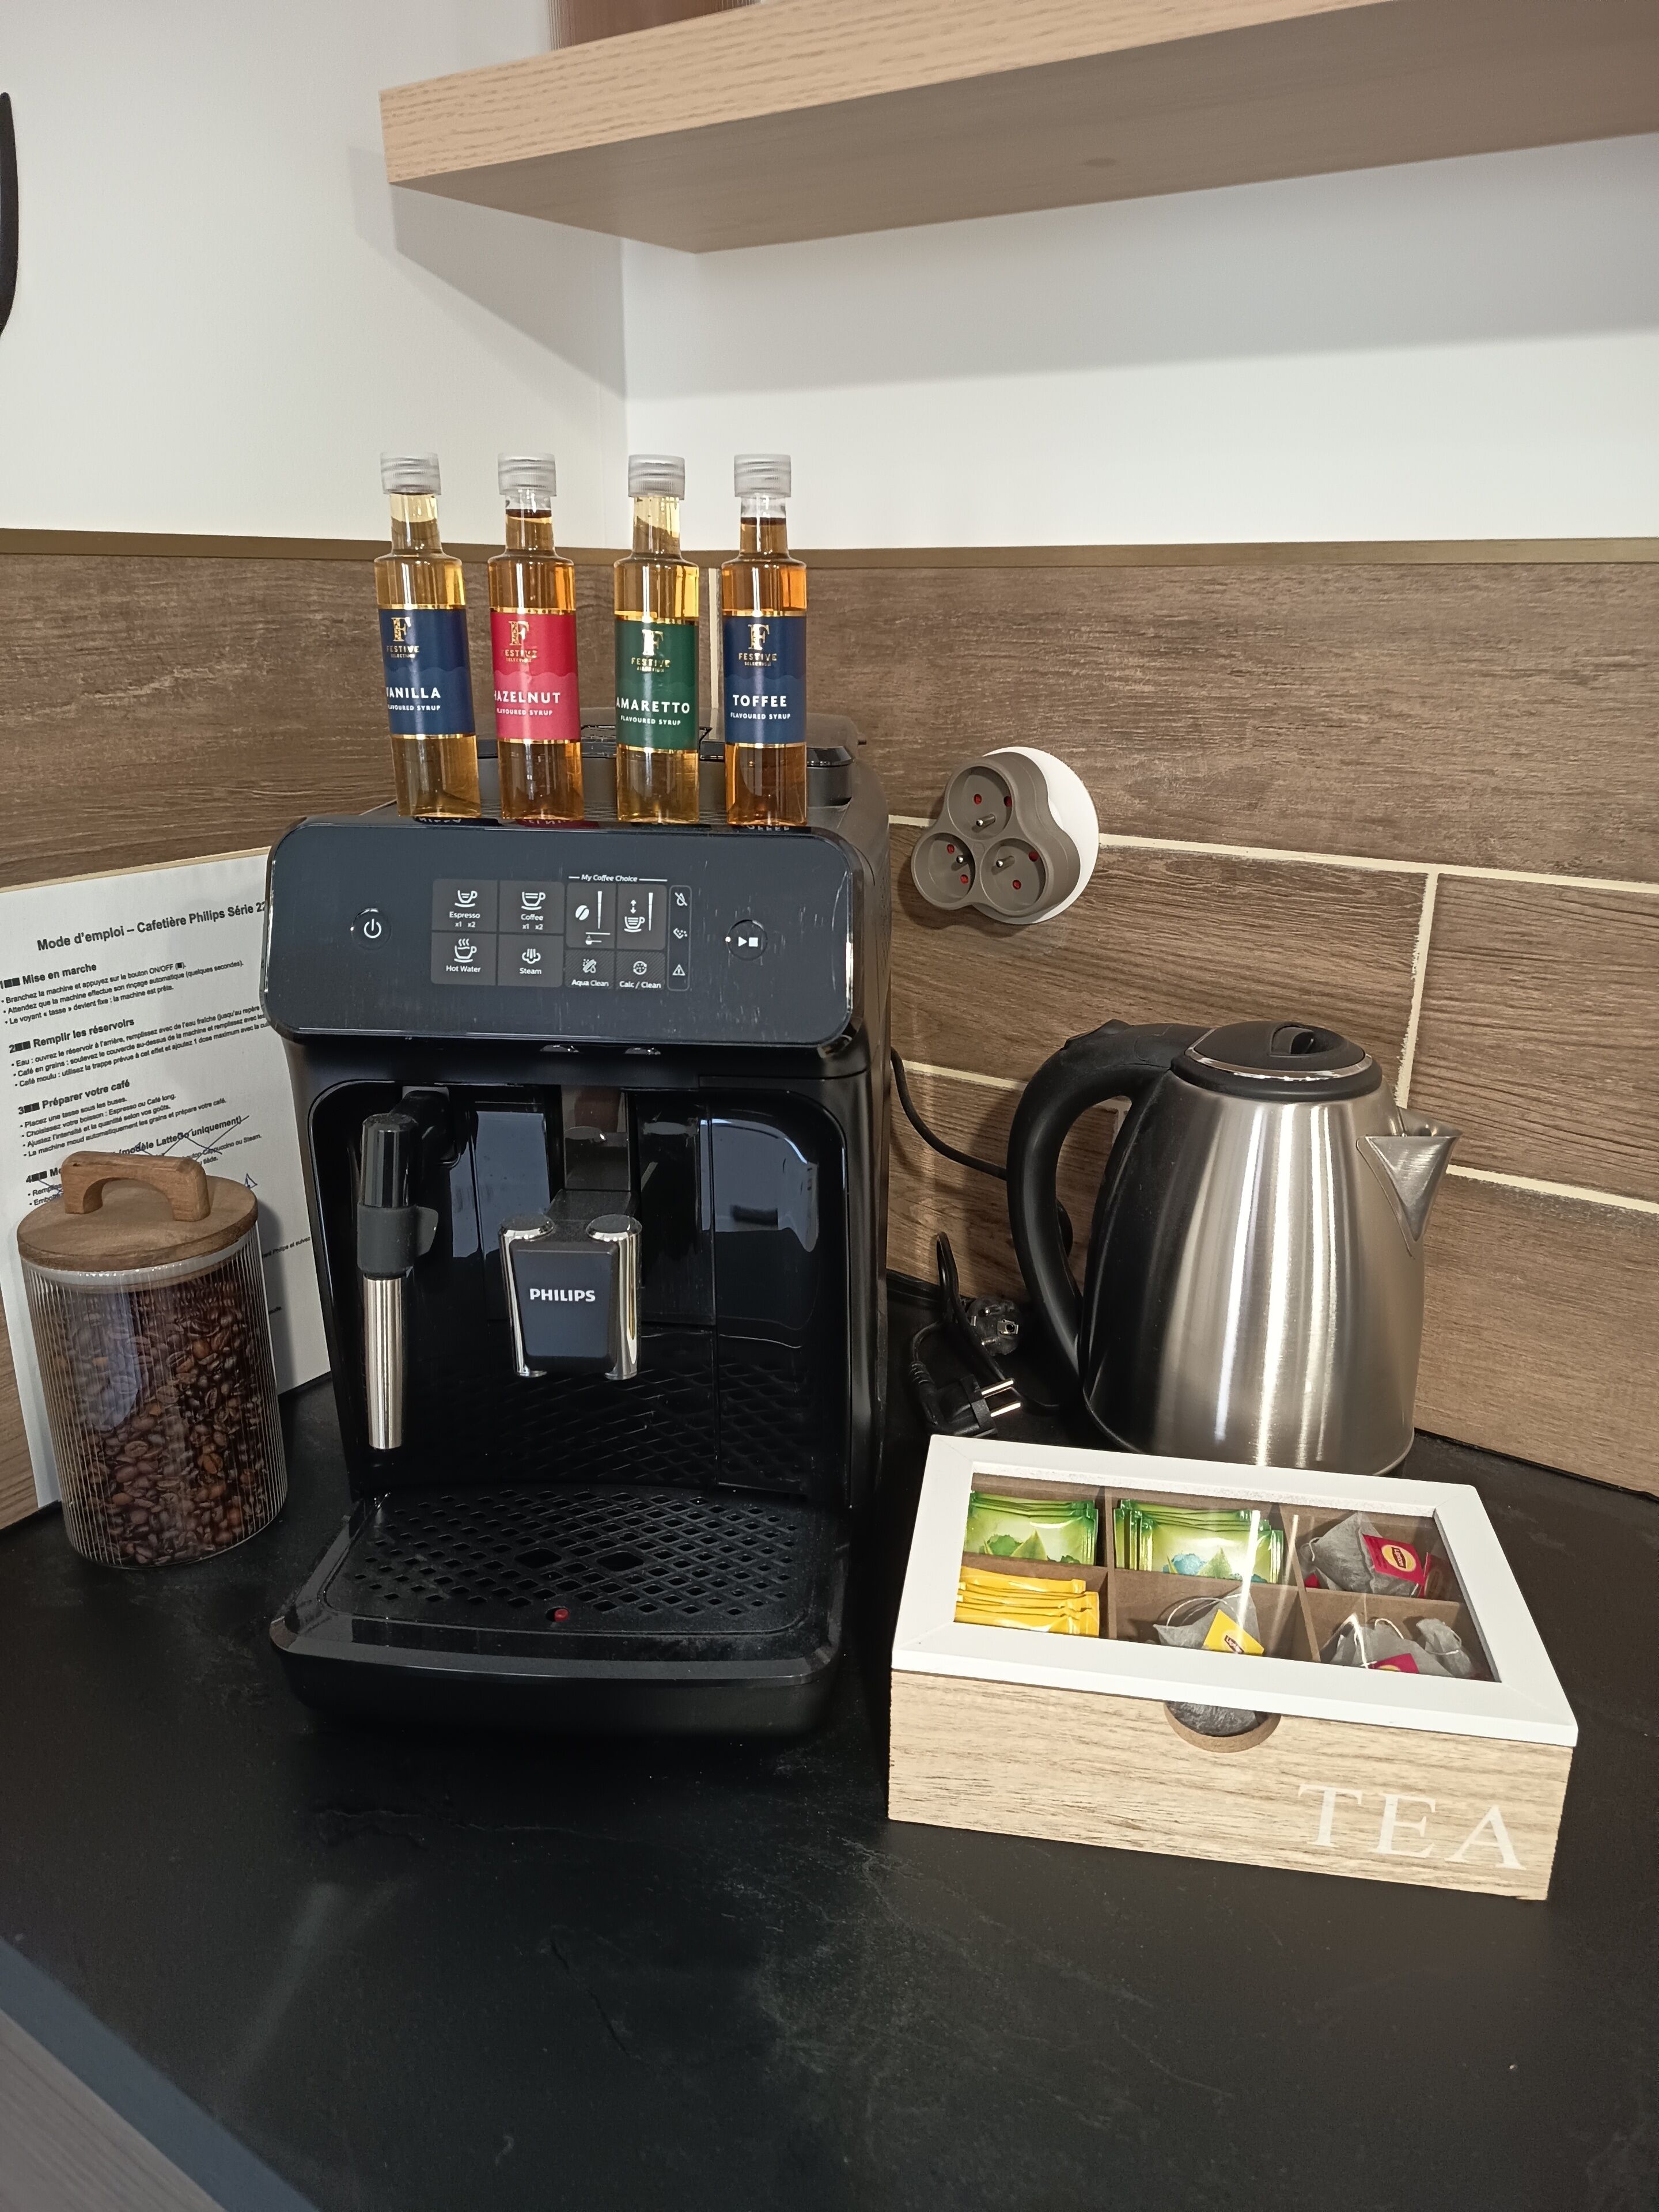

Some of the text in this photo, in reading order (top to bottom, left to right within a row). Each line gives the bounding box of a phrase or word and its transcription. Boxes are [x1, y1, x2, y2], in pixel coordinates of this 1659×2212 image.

[387, 645, 419, 653] FESTIVE
[504, 650, 537, 658] ESTIVE
[738, 653, 777, 661] FESTIVE
[616, 697, 690, 713] AMARETTO
[733, 695, 787, 707] TOFFEE
[621, 715, 656, 724] FLAVOURED
[449, 911, 480, 919] Espresso
[37, 935, 71, 951] Mode
[137, 916, 187, 933] Cafetière
[188, 910, 225, 924] Philips
[227, 904, 254, 917] Série
[22, 963, 97, 985] Mise en marche
[33, 1018, 135, 1048] Remplir les réservoirs
[41, 1079, 130, 1109] Préparer votre café
[530, 1288, 596, 1302] PHILIPS
[1393, 1548, 1405, 1567] Lipton
[1298, 1785, 1527, 1870] TEA
